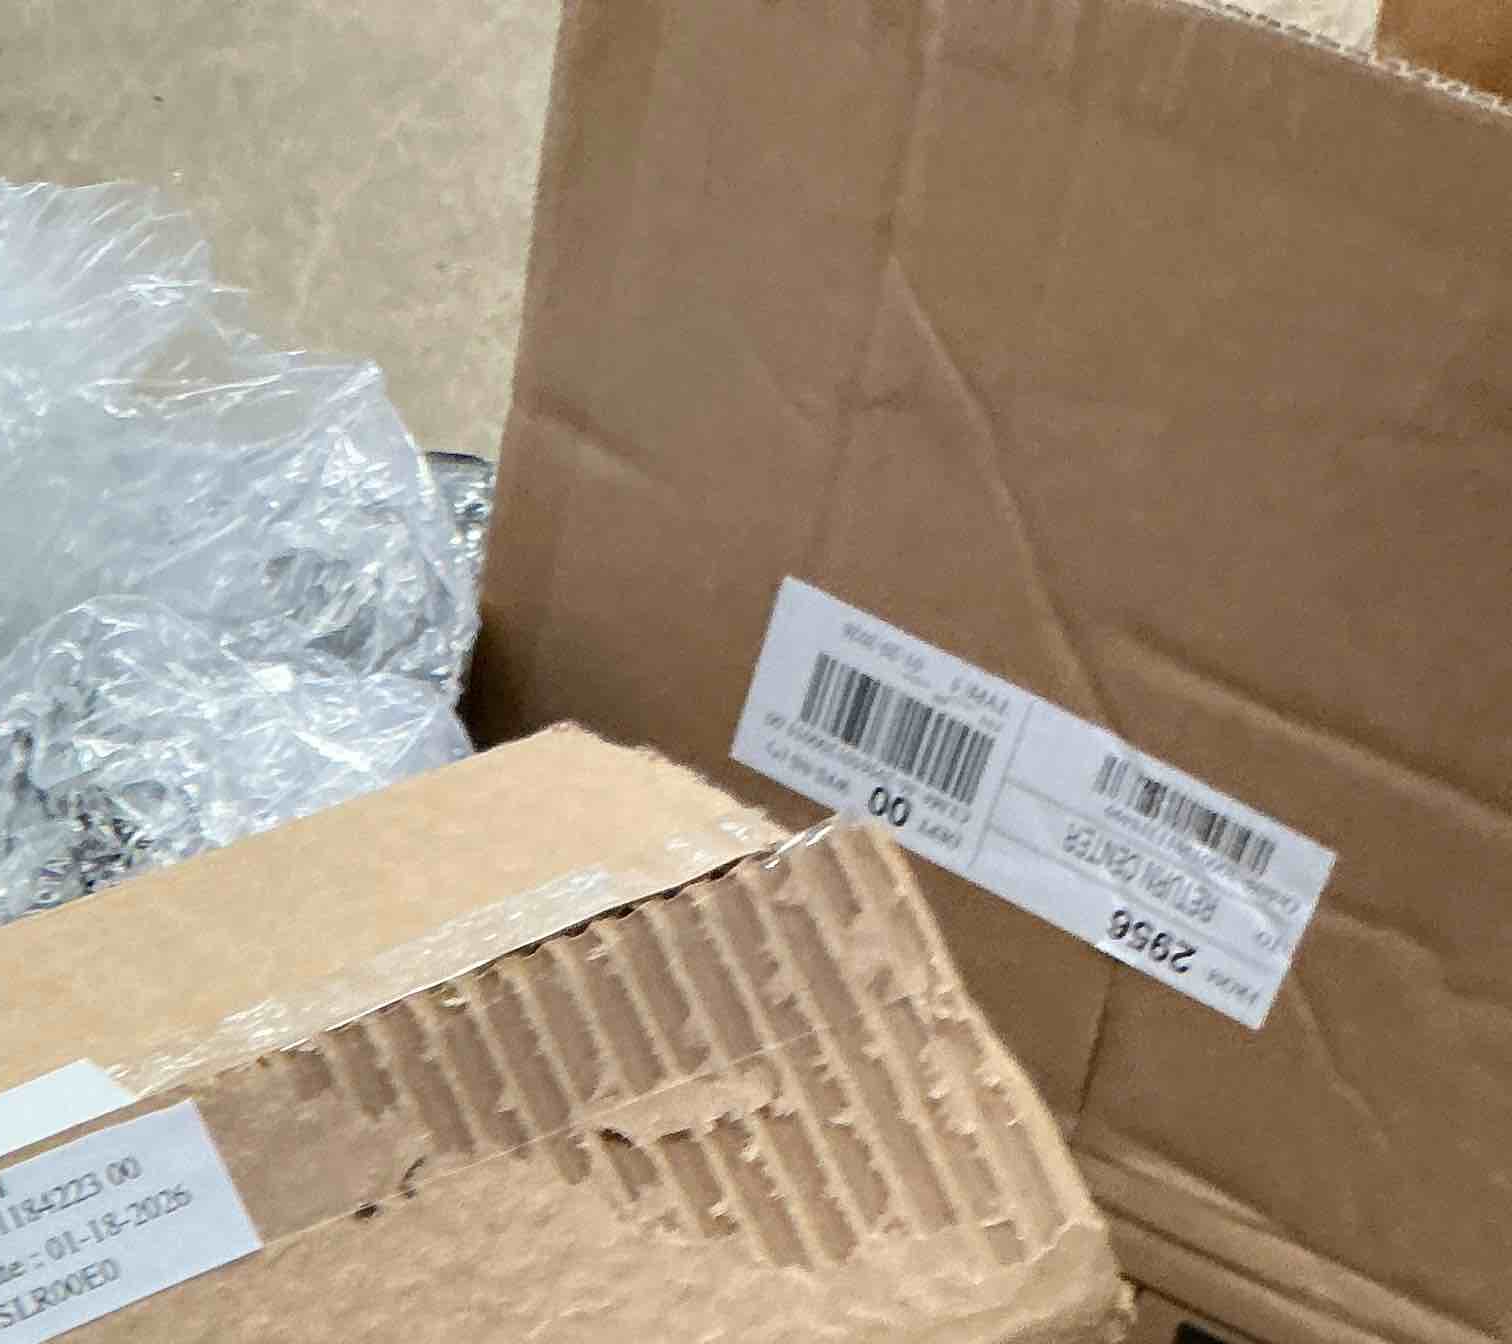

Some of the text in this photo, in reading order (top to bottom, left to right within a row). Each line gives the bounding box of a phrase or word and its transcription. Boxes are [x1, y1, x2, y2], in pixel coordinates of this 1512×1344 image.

[867, 786, 913, 827] 00
[1107, 909, 1199, 974] 2956
[105, 1155, 143, 1184] 00
